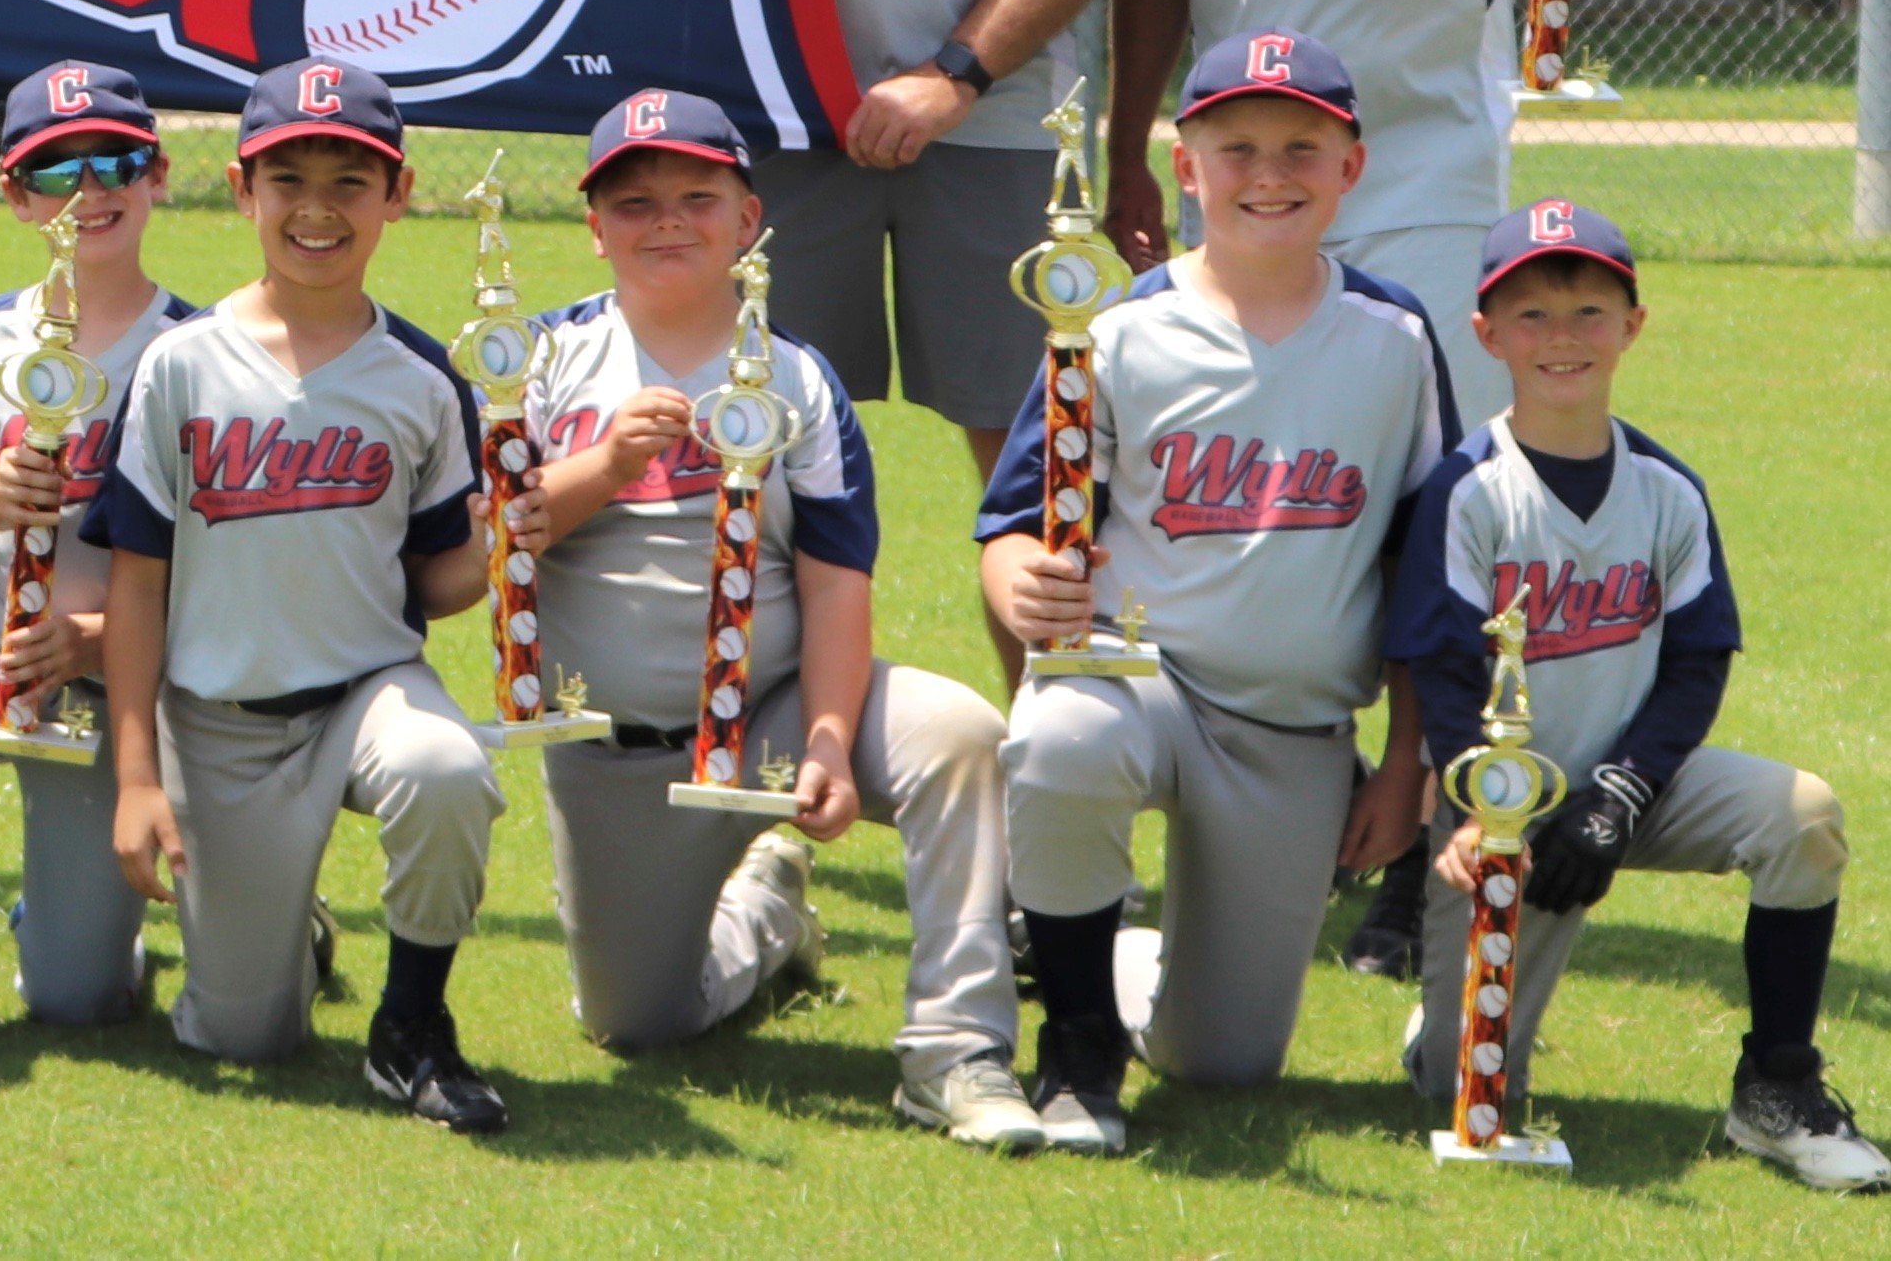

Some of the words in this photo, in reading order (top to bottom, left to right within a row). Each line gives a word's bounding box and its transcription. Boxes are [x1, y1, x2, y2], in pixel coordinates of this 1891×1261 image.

[563, 55, 613, 76] TM
[1247, 34, 1293, 86] C
[47, 68, 92, 116] C
[298, 64, 342, 116] C
[624, 90, 667, 140] C
[1529, 199, 1575, 244] C
[180, 416, 393, 496] Wylie
[1151, 431, 1367, 516] Wylie
